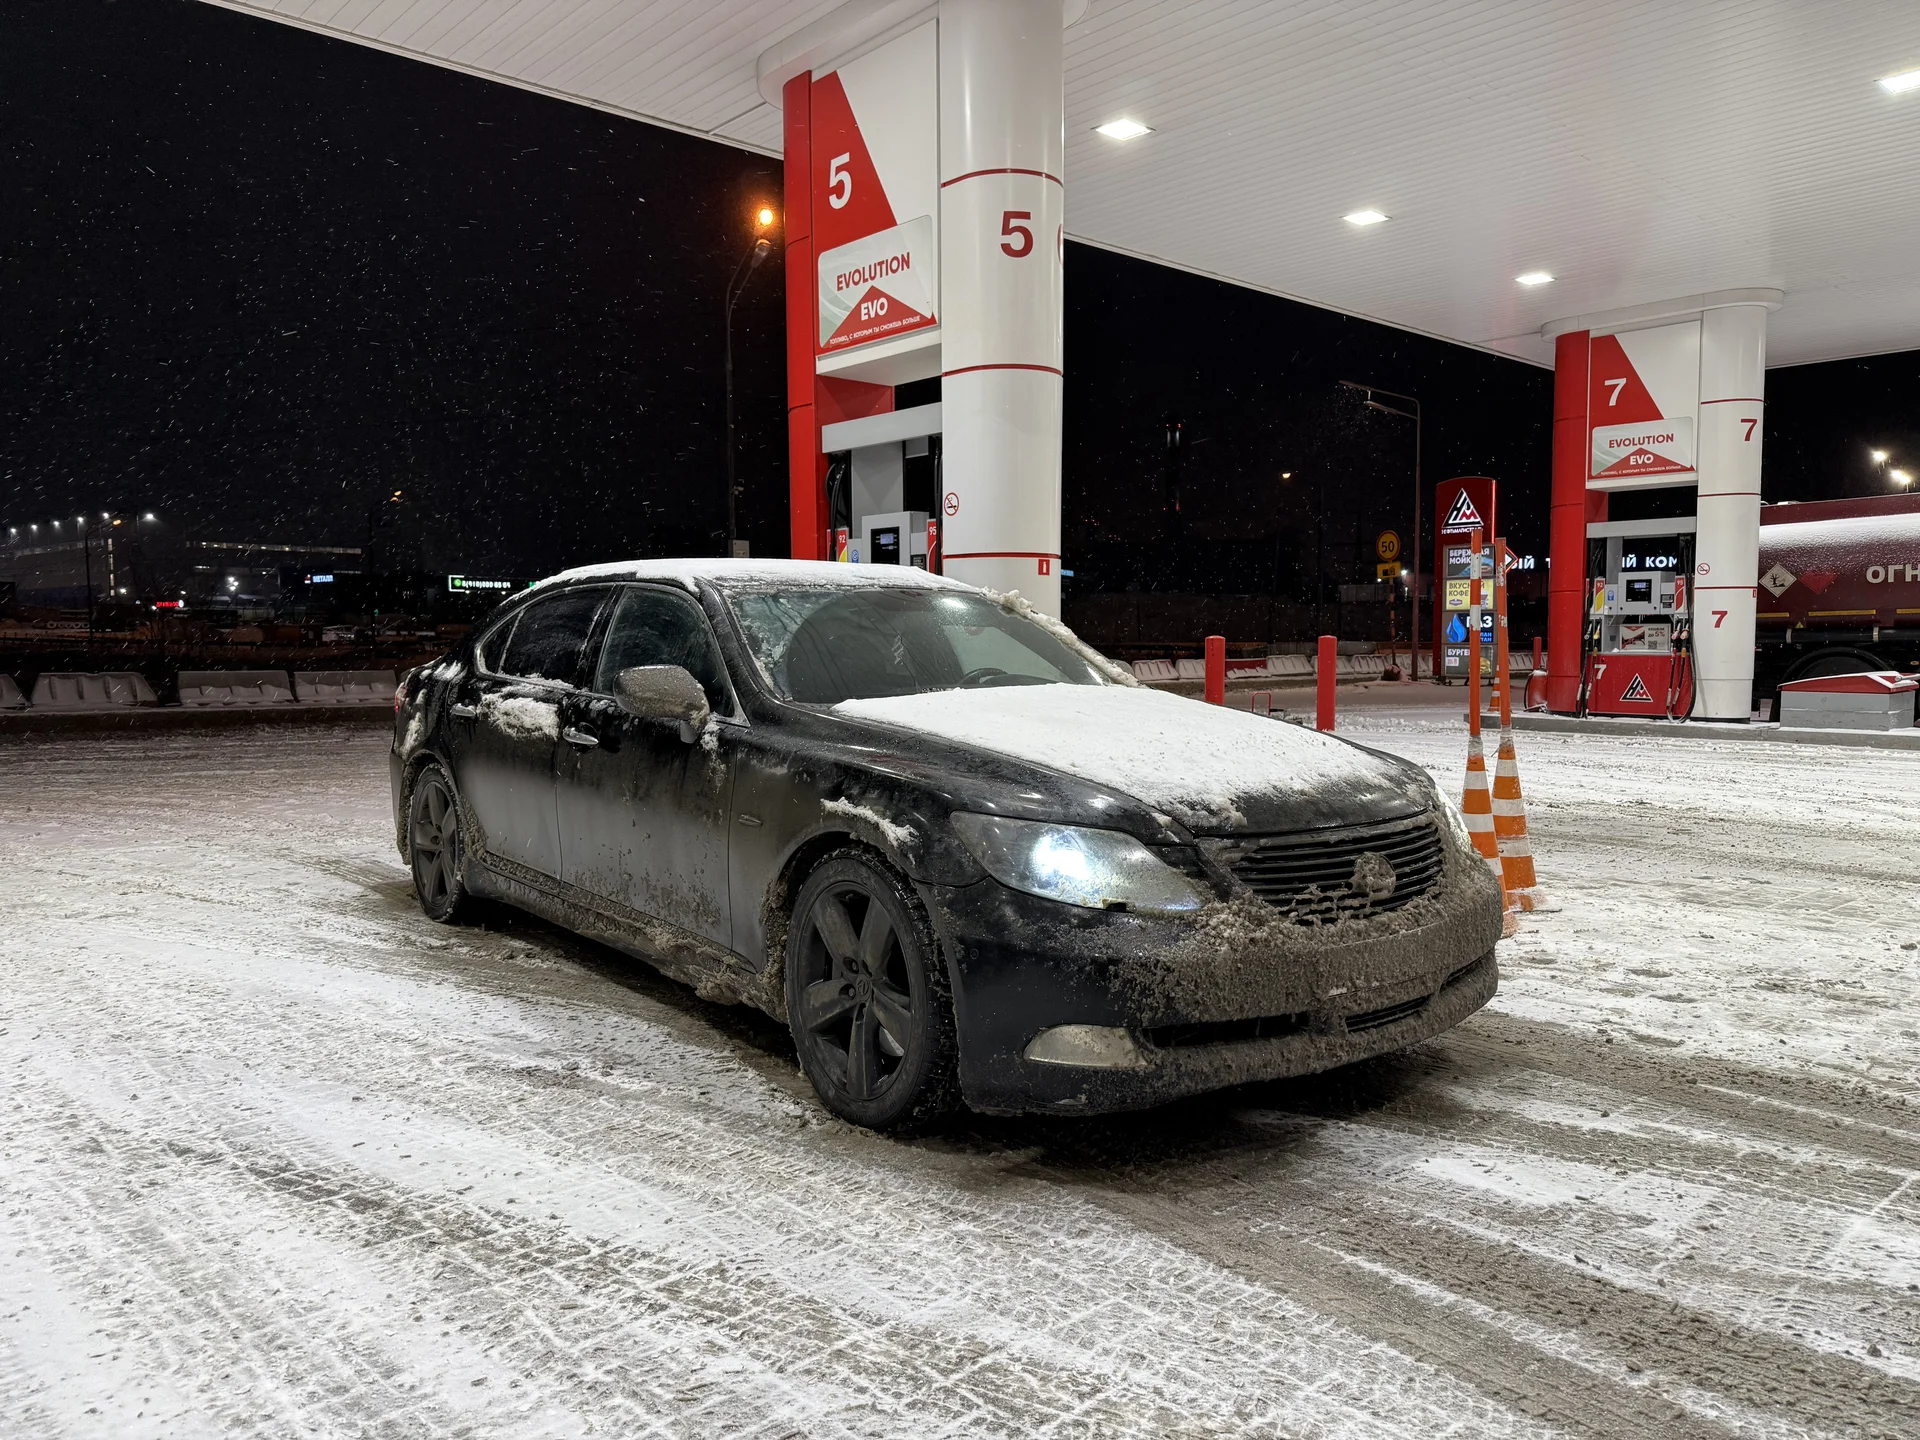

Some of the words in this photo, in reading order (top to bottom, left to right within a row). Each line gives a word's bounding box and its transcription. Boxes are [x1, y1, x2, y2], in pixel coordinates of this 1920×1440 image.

[829, 151, 852, 209] 5
[1000, 210, 1034, 258] 5
[836, 251, 911, 292] EVOLUTION
[860, 297, 888, 321] EVO
[1604, 377, 1627, 407] 7
[1740, 418, 1758, 442] 7
[1608, 433, 1675, 449] EVOLUTION
[1629, 453, 1654, 466] EVO
[838, 535, 846, 543] 92
[929, 527, 936, 535] 95
[1381, 540, 1395, 553] 50
[1449, 557, 1471, 565] МОЙК
[1866, 563, 1920, 584] ОГН
[1449, 589, 1469, 597] КОФЕ
[1711, 610, 1728, 629] 7
[1594, 663, 1608, 680] 7
